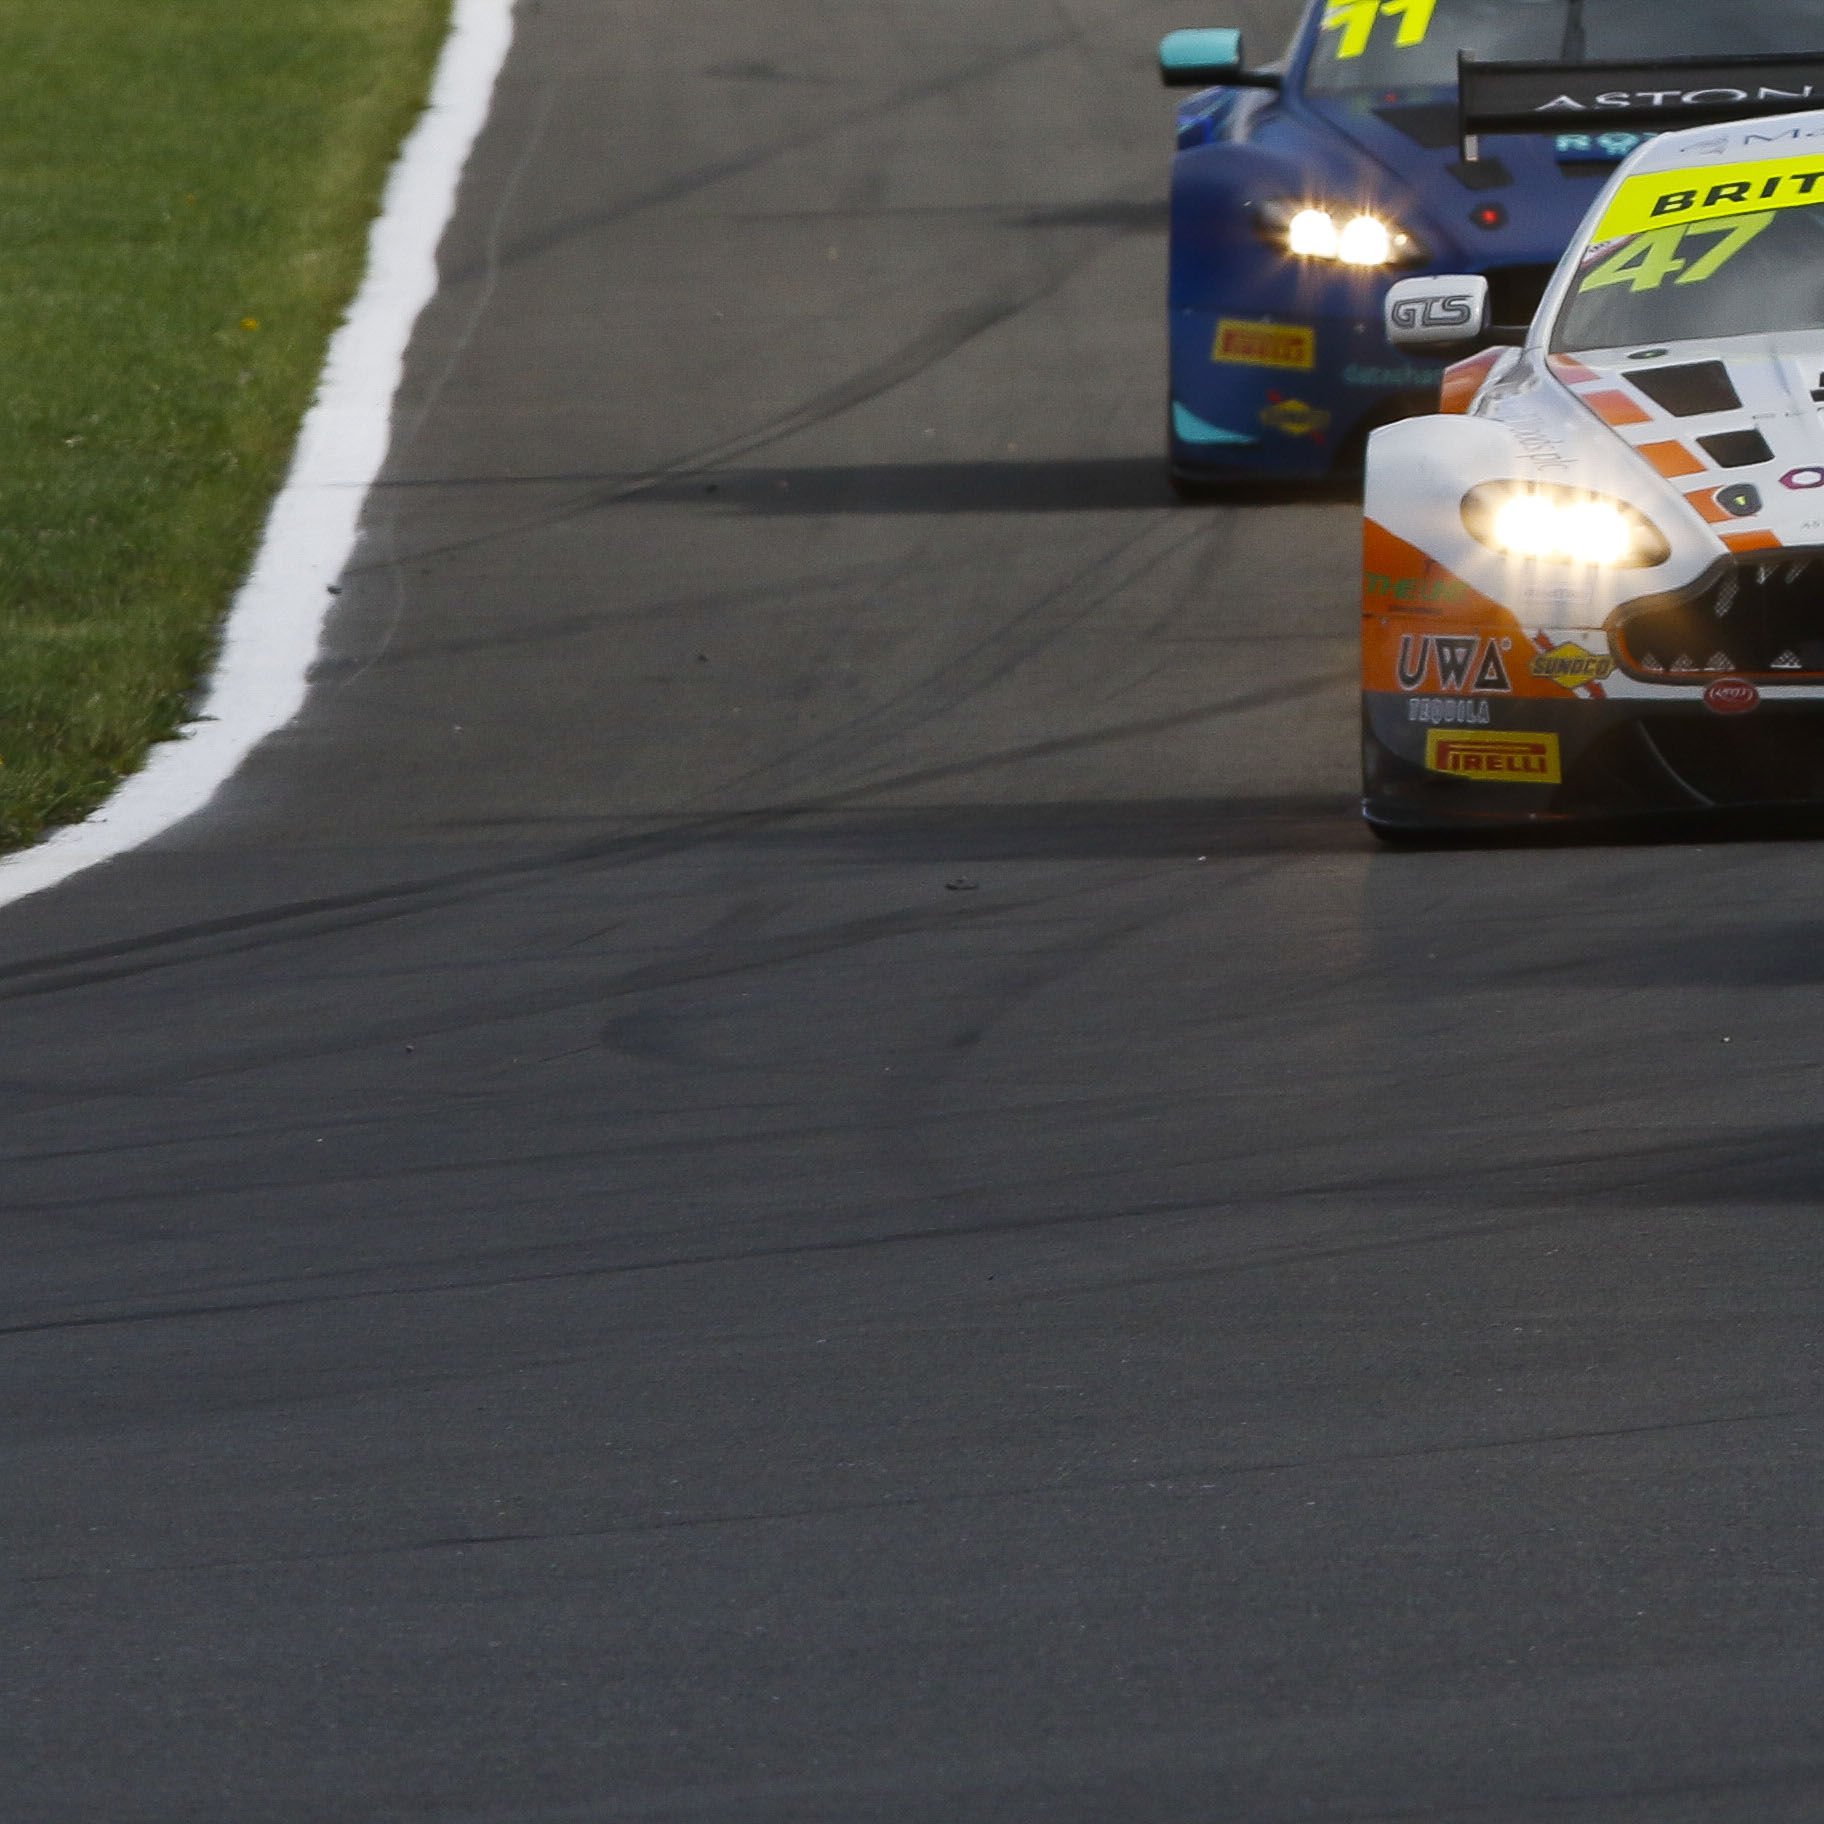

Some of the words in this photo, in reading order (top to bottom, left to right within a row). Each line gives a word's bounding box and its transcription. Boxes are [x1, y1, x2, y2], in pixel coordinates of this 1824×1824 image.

[1536, 85, 1813, 111] ASTON
[1579, 211, 1776, 294] 47
[1392, 294, 1472, 328] GTS
[1532, 656, 1614, 676] SUNOCO
[1408, 698, 1491, 724] TEQUILA
[1437, 741, 1548, 774] PIRELLI
